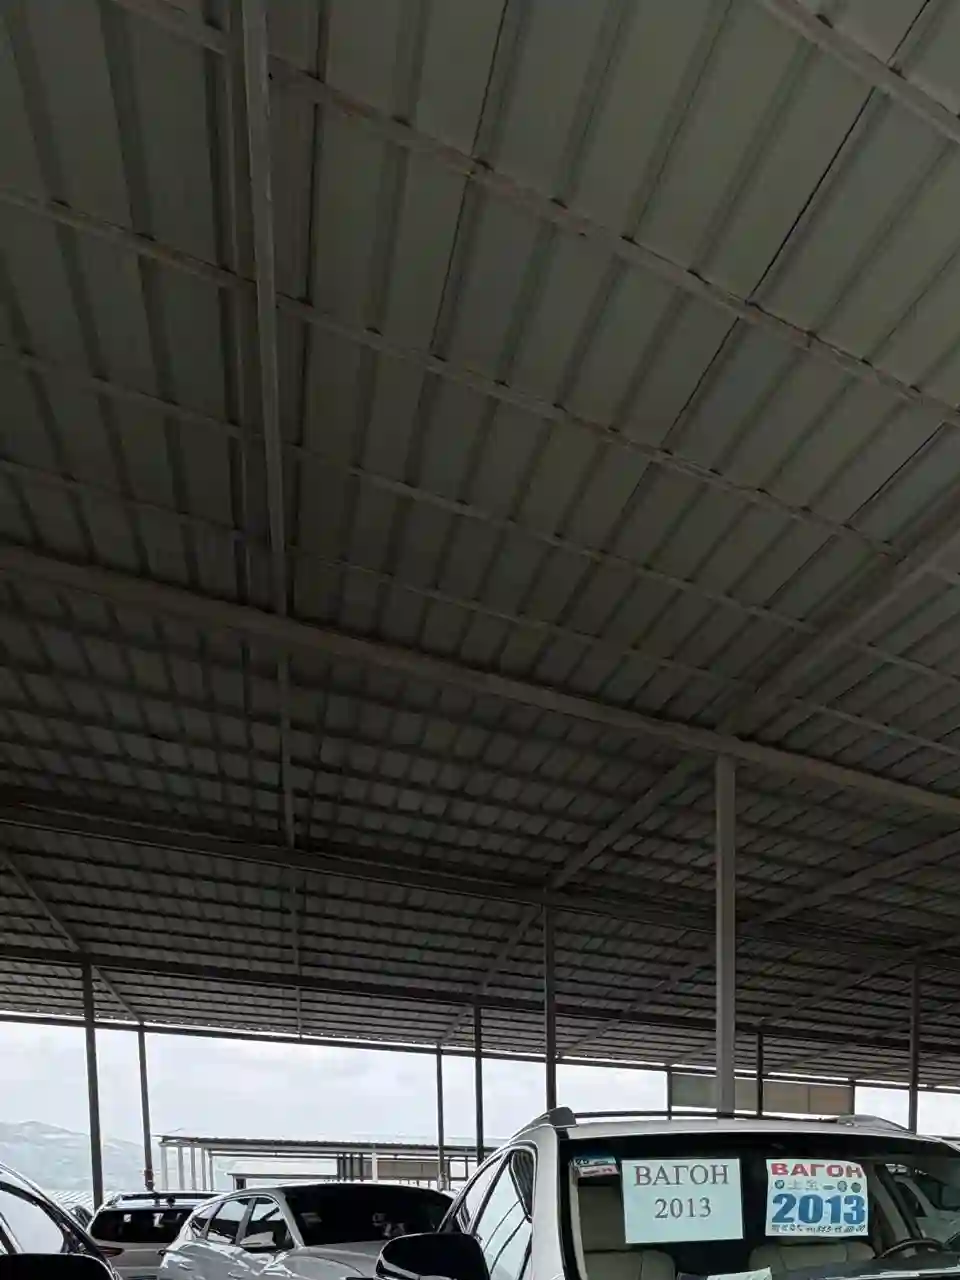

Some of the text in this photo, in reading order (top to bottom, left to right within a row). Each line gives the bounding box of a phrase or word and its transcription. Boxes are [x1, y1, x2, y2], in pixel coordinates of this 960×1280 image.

[633, 1163, 729, 1187] ВАГОН
[770, 1163, 863, 1179] ВАГОН
[654, 1197, 712, 1219] 2013
[771, 1193, 866, 1225] 2013
